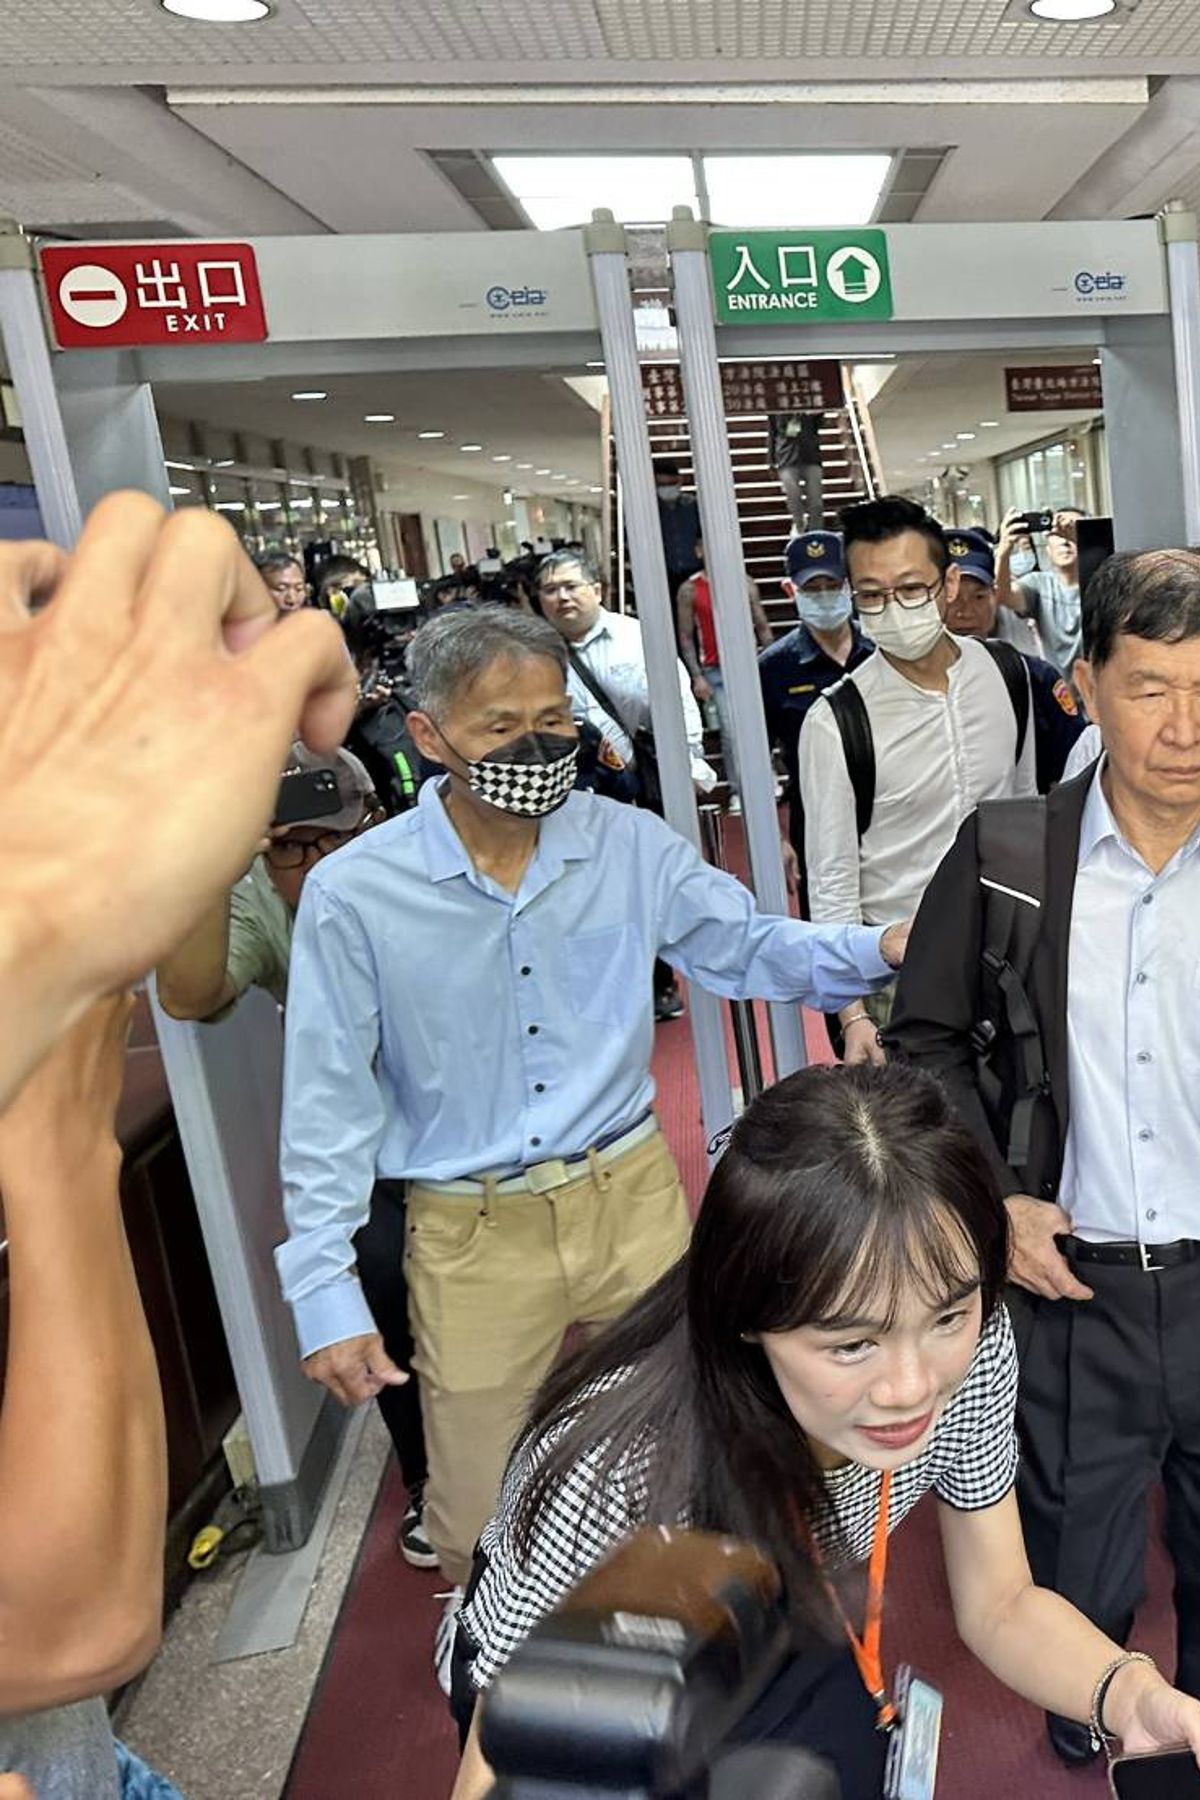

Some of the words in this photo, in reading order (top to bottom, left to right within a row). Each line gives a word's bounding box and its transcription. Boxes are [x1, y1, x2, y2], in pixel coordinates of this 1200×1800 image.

[135, 259, 247, 309] 出口
[726, 246, 819, 290] 入口
[728, 292, 819, 310] ENTRANCE
[165, 313, 226, 333] EXIT
